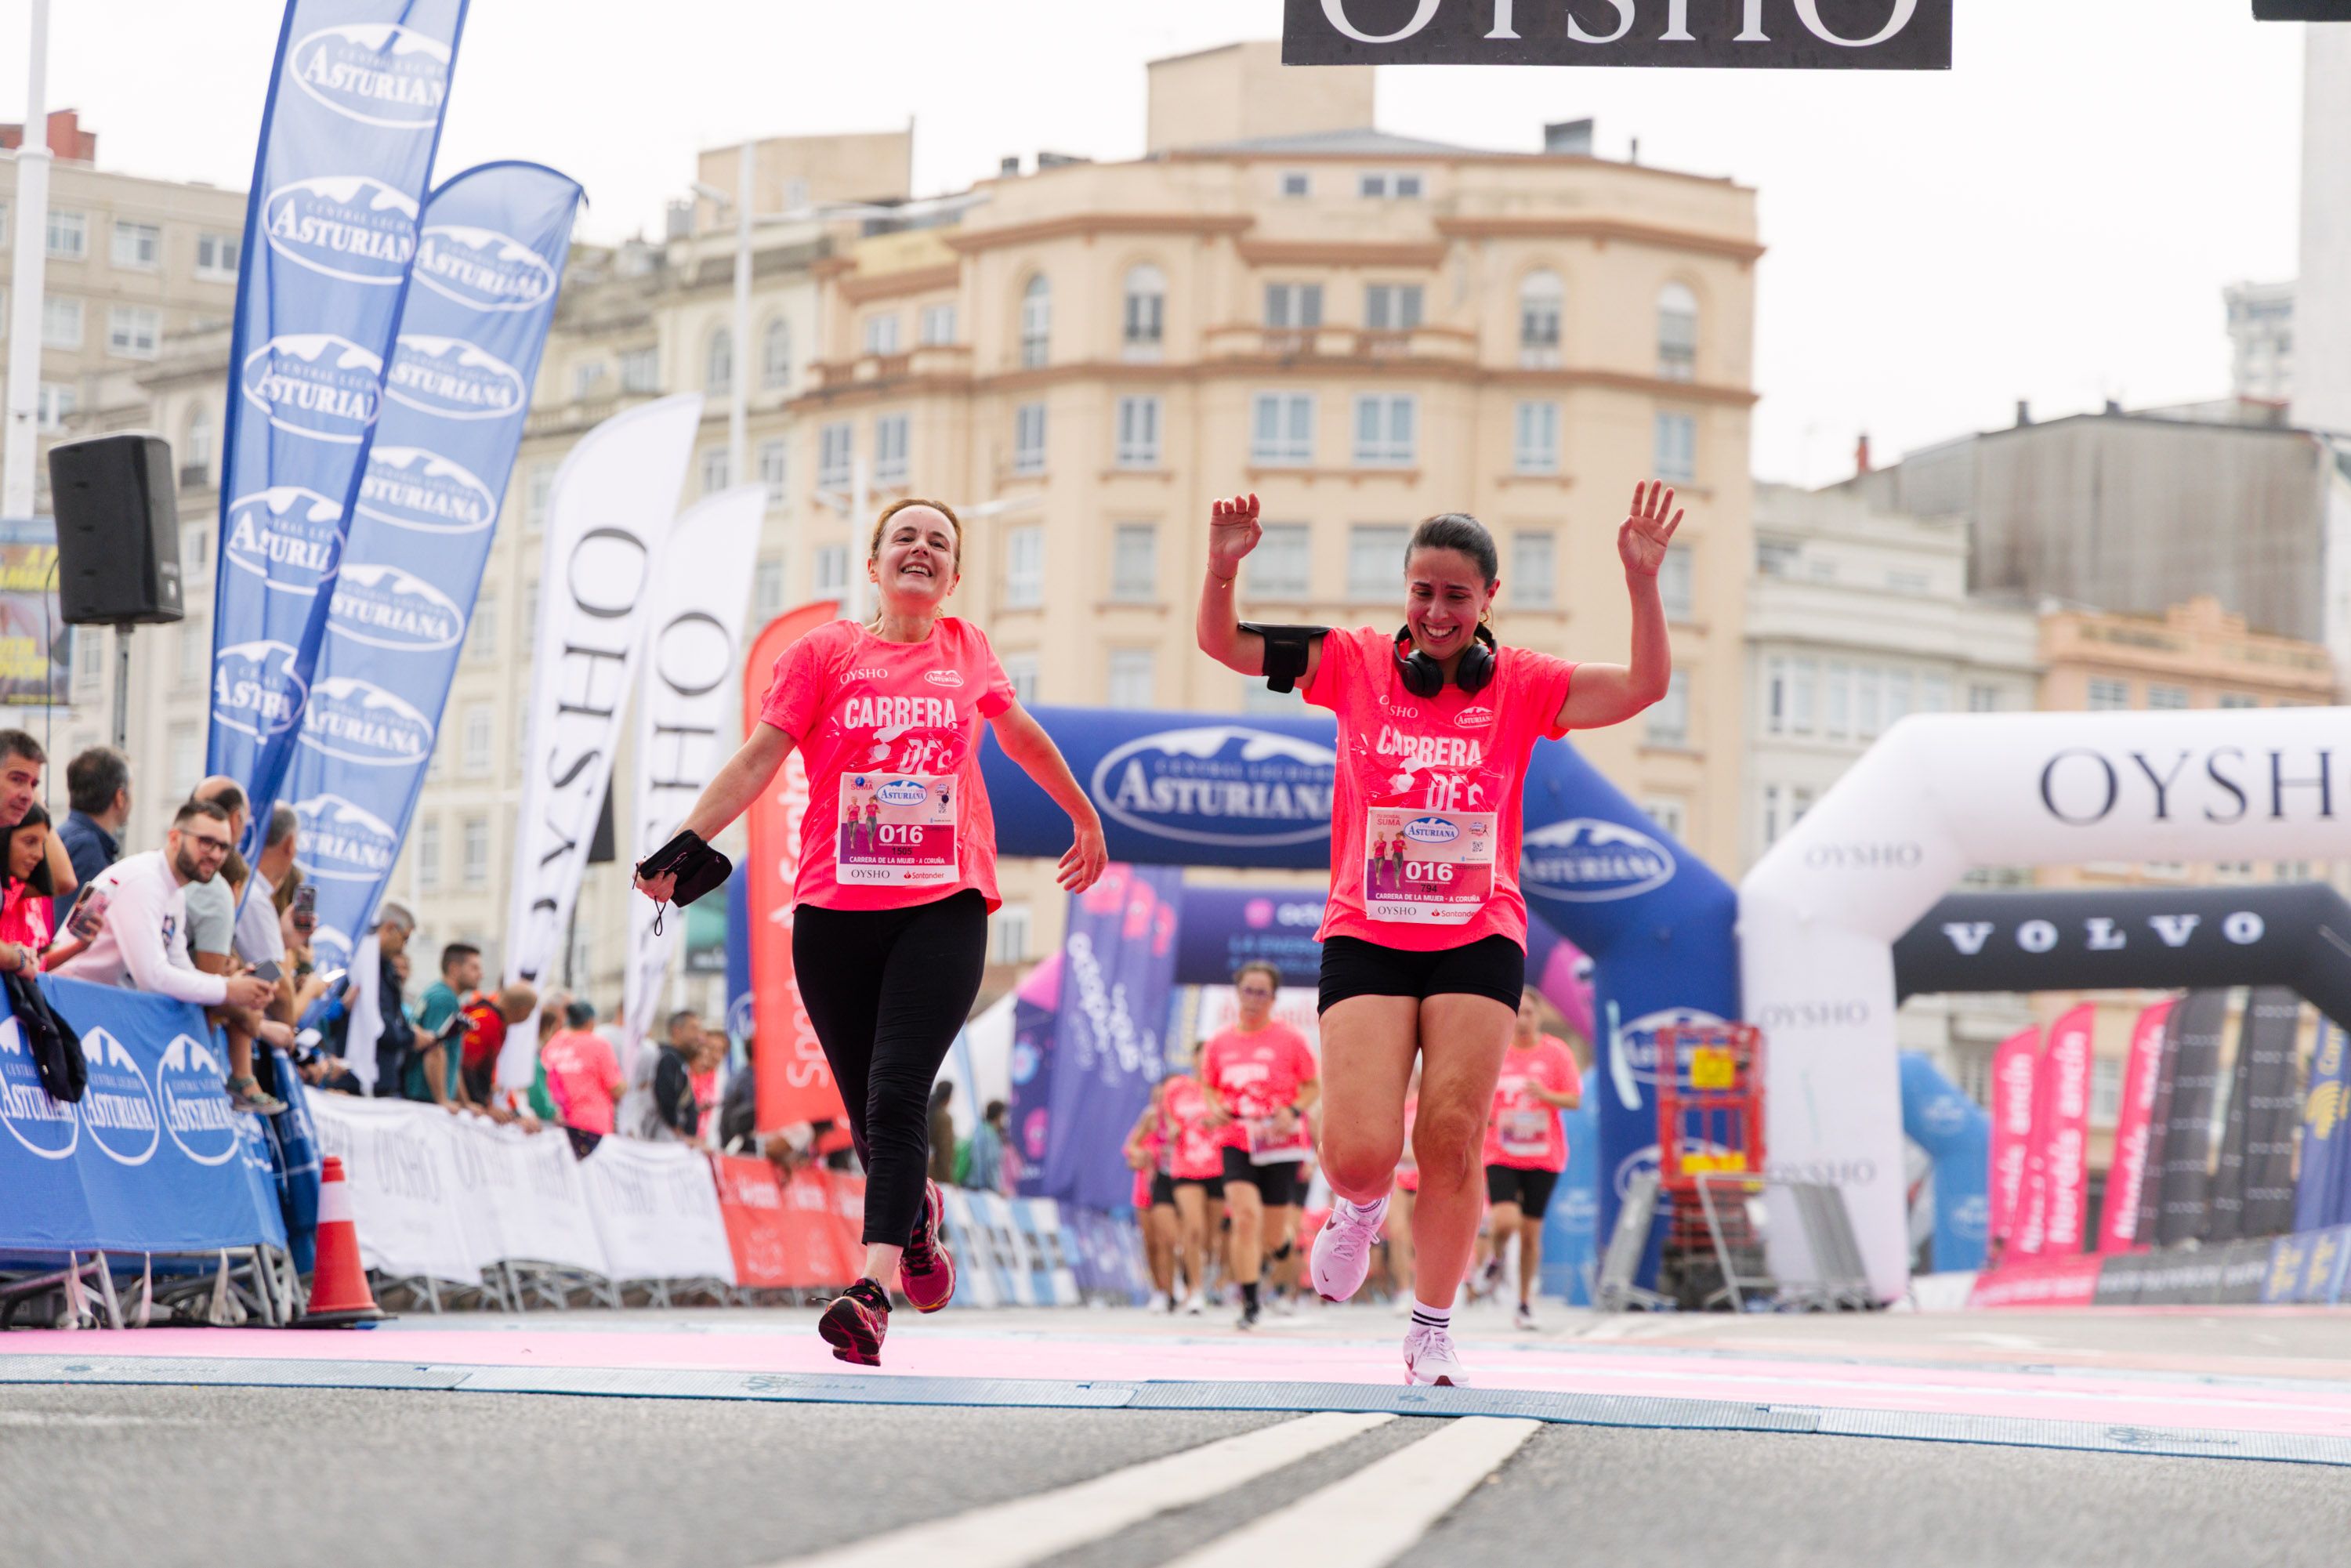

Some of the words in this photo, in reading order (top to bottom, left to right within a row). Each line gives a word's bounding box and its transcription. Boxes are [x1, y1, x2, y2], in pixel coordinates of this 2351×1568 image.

[303, 42, 444, 107] ASTURIAN
[272, 197, 415, 264] ASTURIAN
[388, 361, 512, 410] STURIANA
[360, 476, 481, 525] STURIANA
[329, 591, 450, 642] STURIANA
[839, 668, 888, 685] OYSHO
[844, 696, 958, 730] CARRERA
[1379, 694, 1418, 719] OSHO
[1458, 715, 1493, 725] ASTURIAN
[1375, 724, 1483, 767] CARRERA
[881, 788, 924, 801] ASTURIANA
[2039, 747, 2336, 827] OYSH
[879, 824, 924, 844] 016
[1408, 825, 1455, 838] ASTURIANA
[892, 847, 912, 856] 1505
[1806, 841, 1923, 870] OYSHO
[851, 869, 890, 878] OYSHO
[1405, 861, 1453, 882] 016
[1421, 884, 1437, 893] 794
[1378, 906, 1417, 916] OYSHO
[1941, 911, 2265, 956] VOLVO
[85, 1084, 157, 1131] ASTURIANA
